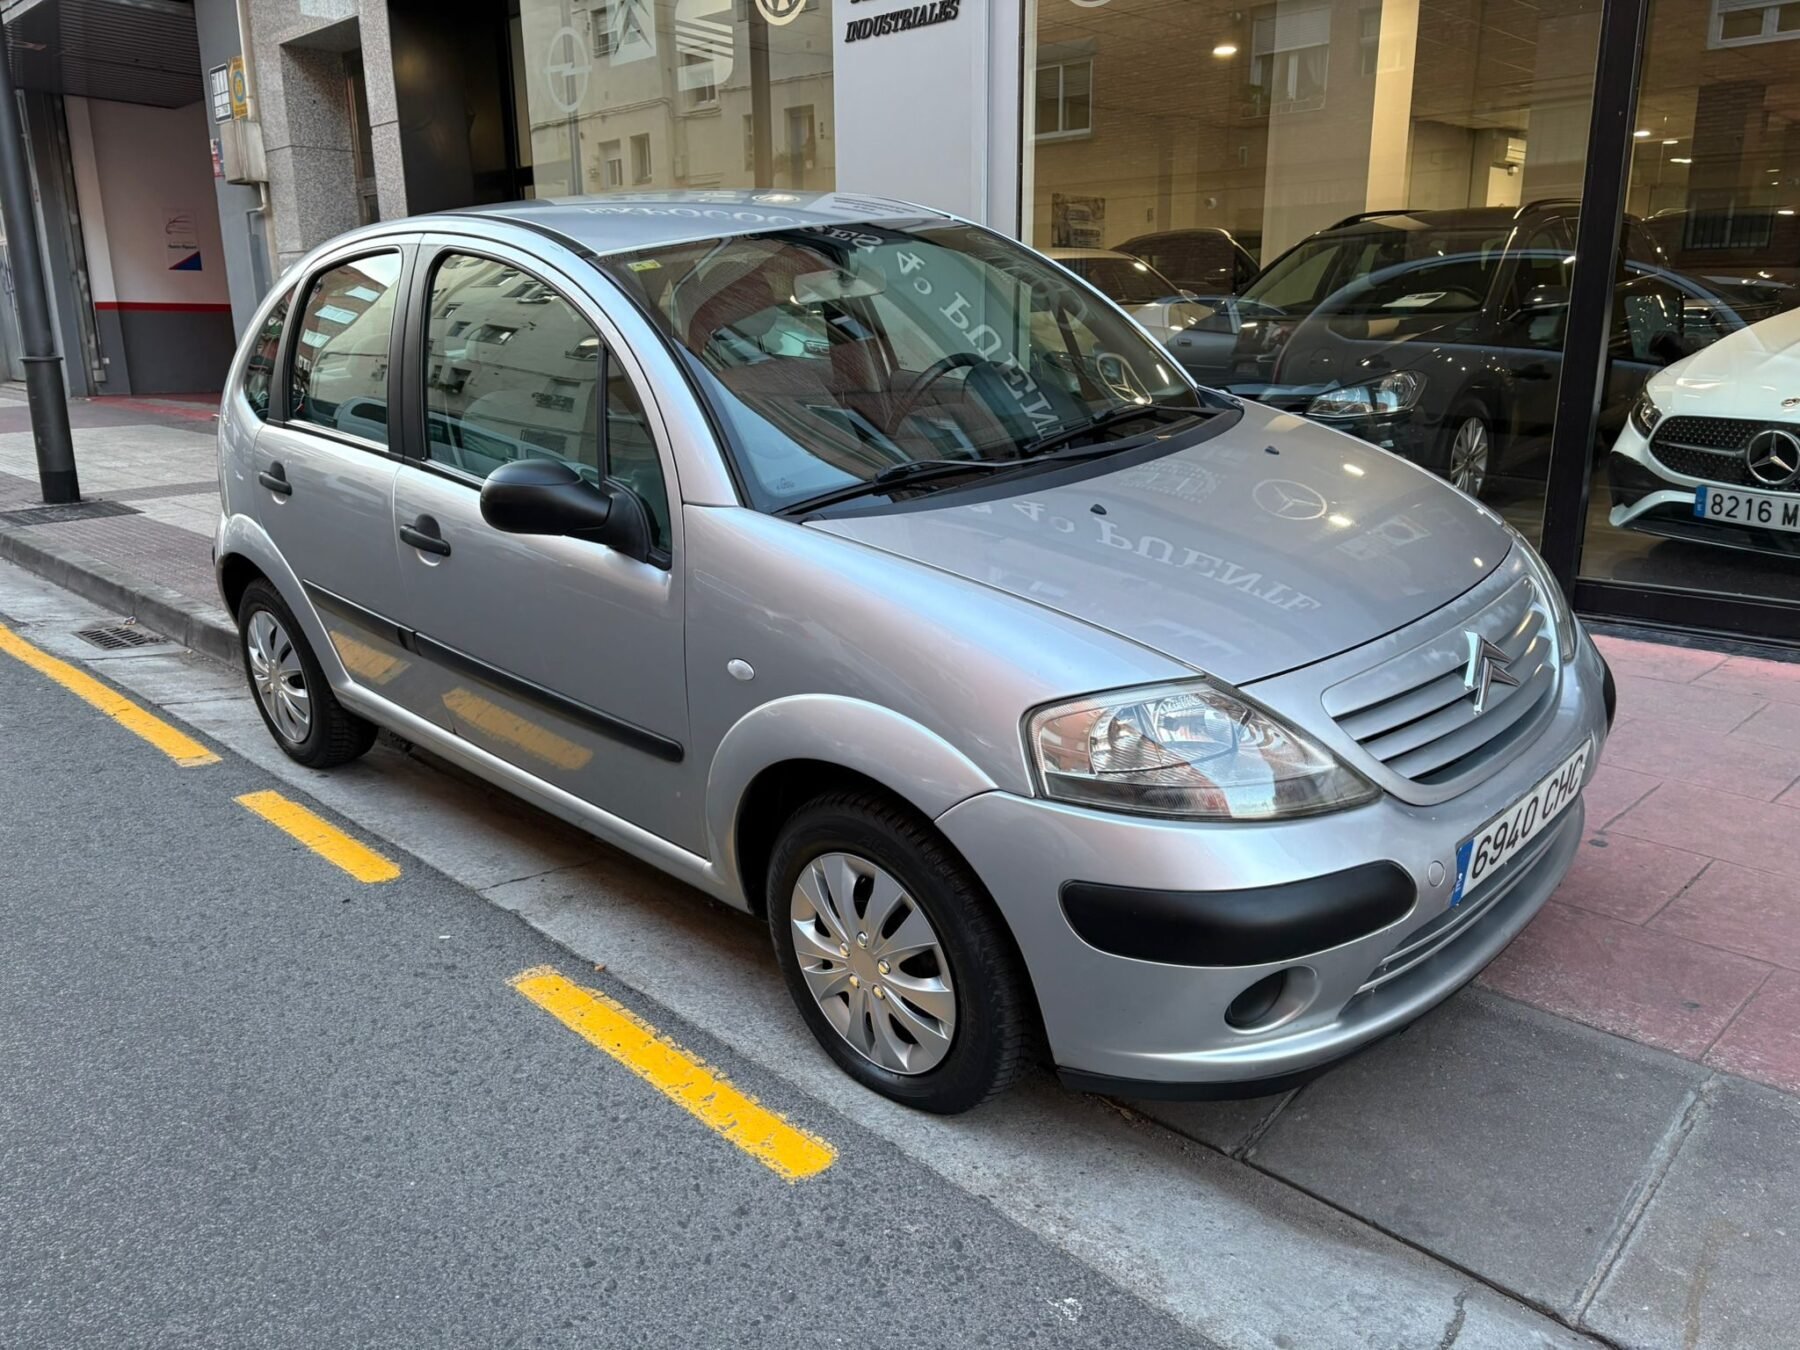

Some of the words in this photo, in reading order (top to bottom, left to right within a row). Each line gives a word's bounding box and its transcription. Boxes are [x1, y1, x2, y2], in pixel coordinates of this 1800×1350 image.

[844, 0, 960, 43] INDUSTRIALES
[1711, 493, 1773, 524] 8216
[1471, 796, 1539, 880] 6940
[1542, 754, 1584, 821] CHC
